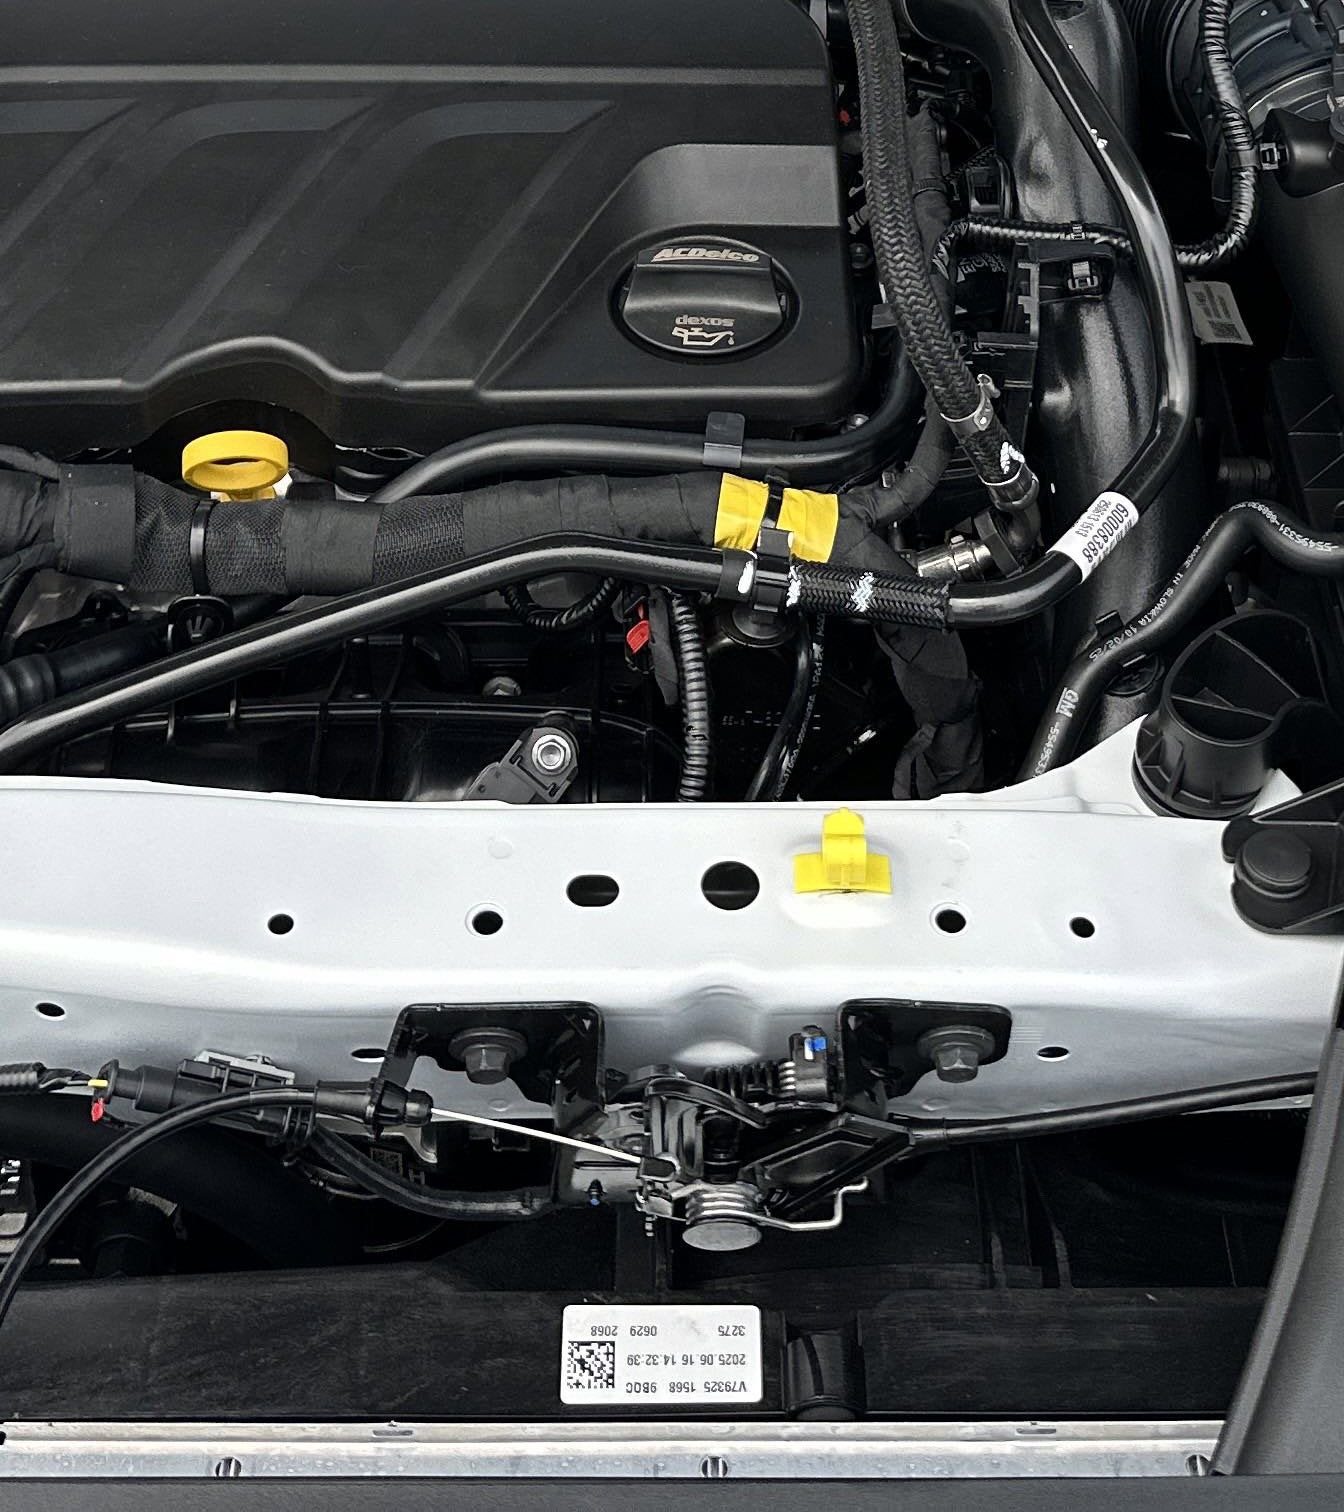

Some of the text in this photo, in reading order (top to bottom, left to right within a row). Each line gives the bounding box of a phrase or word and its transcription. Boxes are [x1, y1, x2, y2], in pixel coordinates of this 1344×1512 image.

[651, 247, 761, 262] ACDelco
[675, 314, 736, 327] dexos
[1082, 503, 1129, 563] 60008388
[1173, 572, 1184, 585] IN
[1033, 687, 1080, 778] GM -5549533
[590, 1325, 746, 1336] 3275 0629 2068
[681, 1353, 746, 1366] 2025.06.16
[669, 1381, 696, 1392] 1568
[703, 1381, 747, 1392] V79325
